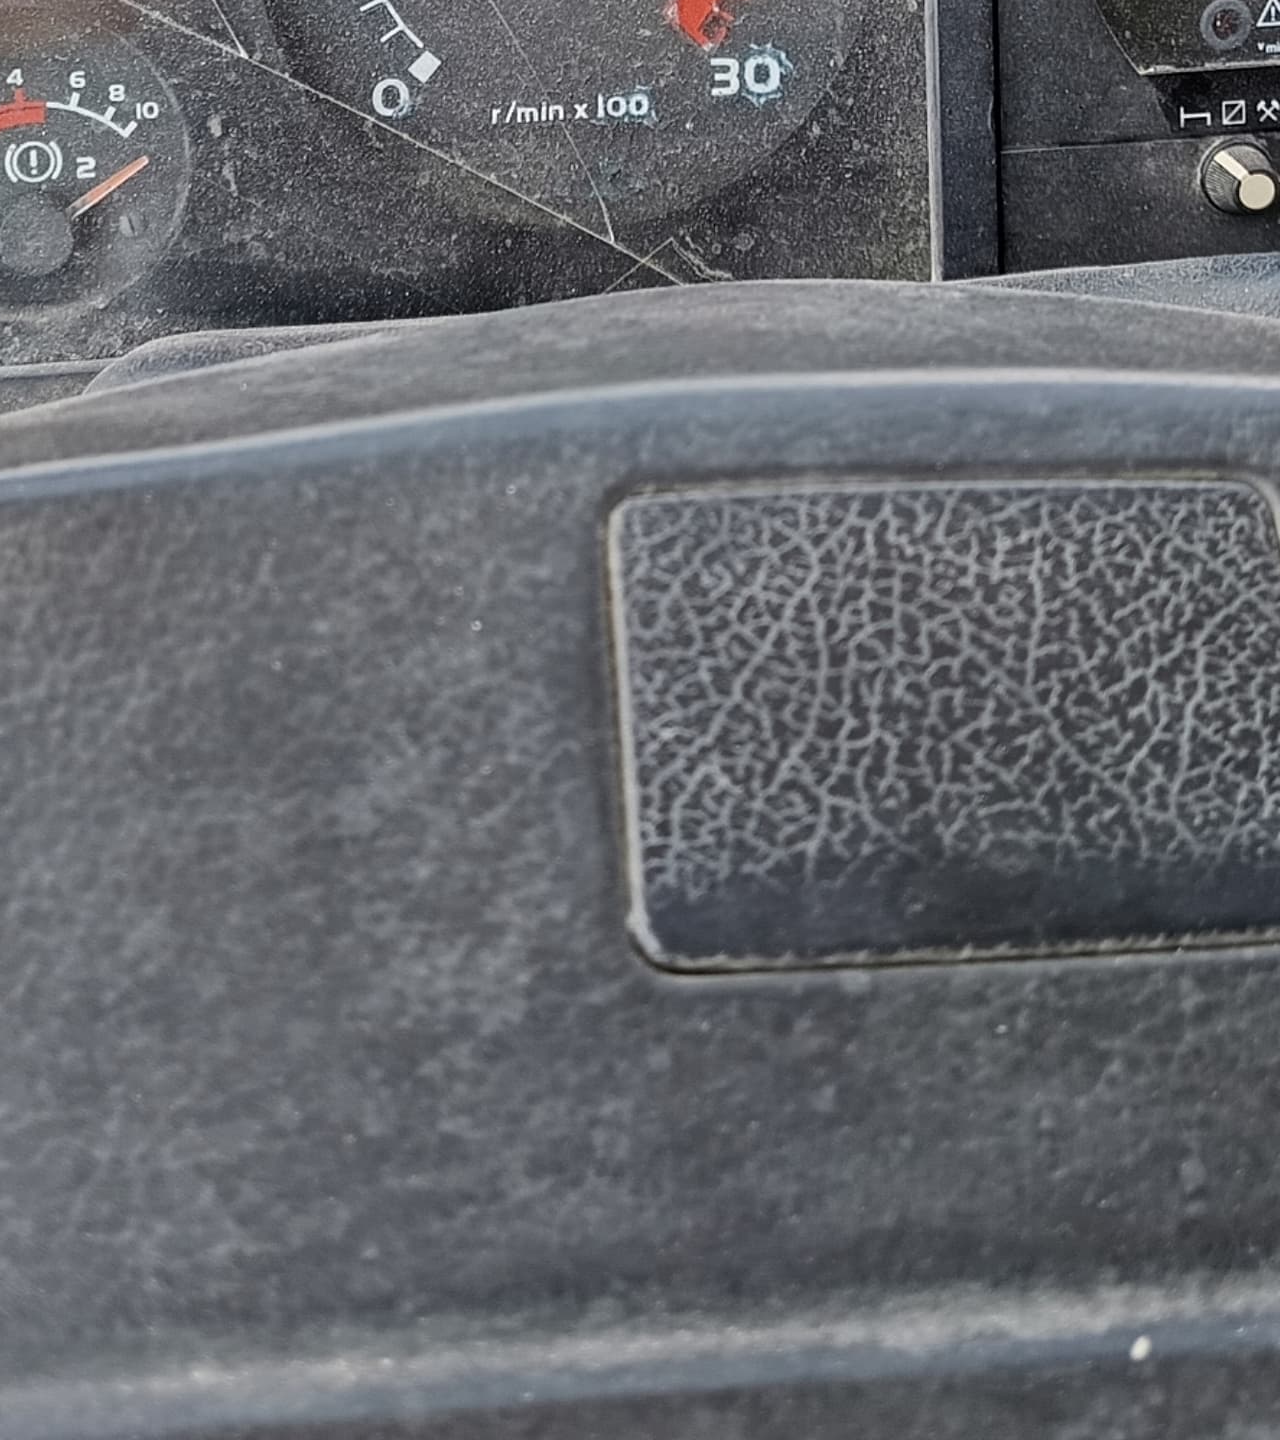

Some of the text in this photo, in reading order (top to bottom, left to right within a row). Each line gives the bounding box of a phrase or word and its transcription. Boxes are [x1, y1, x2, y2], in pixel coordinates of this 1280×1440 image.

[6, 68, 23, 85] 4
[70, 70, 85, 88] 6
[710, 57, 782, 97] 30
[108, 84, 125, 102] 8
[372, 79, 410, 117] 0
[135, 102, 159, 120] 10
[573, 102, 588, 119] x
[597, 93, 650, 120] 100
[76, 156, 96, 179] 2
